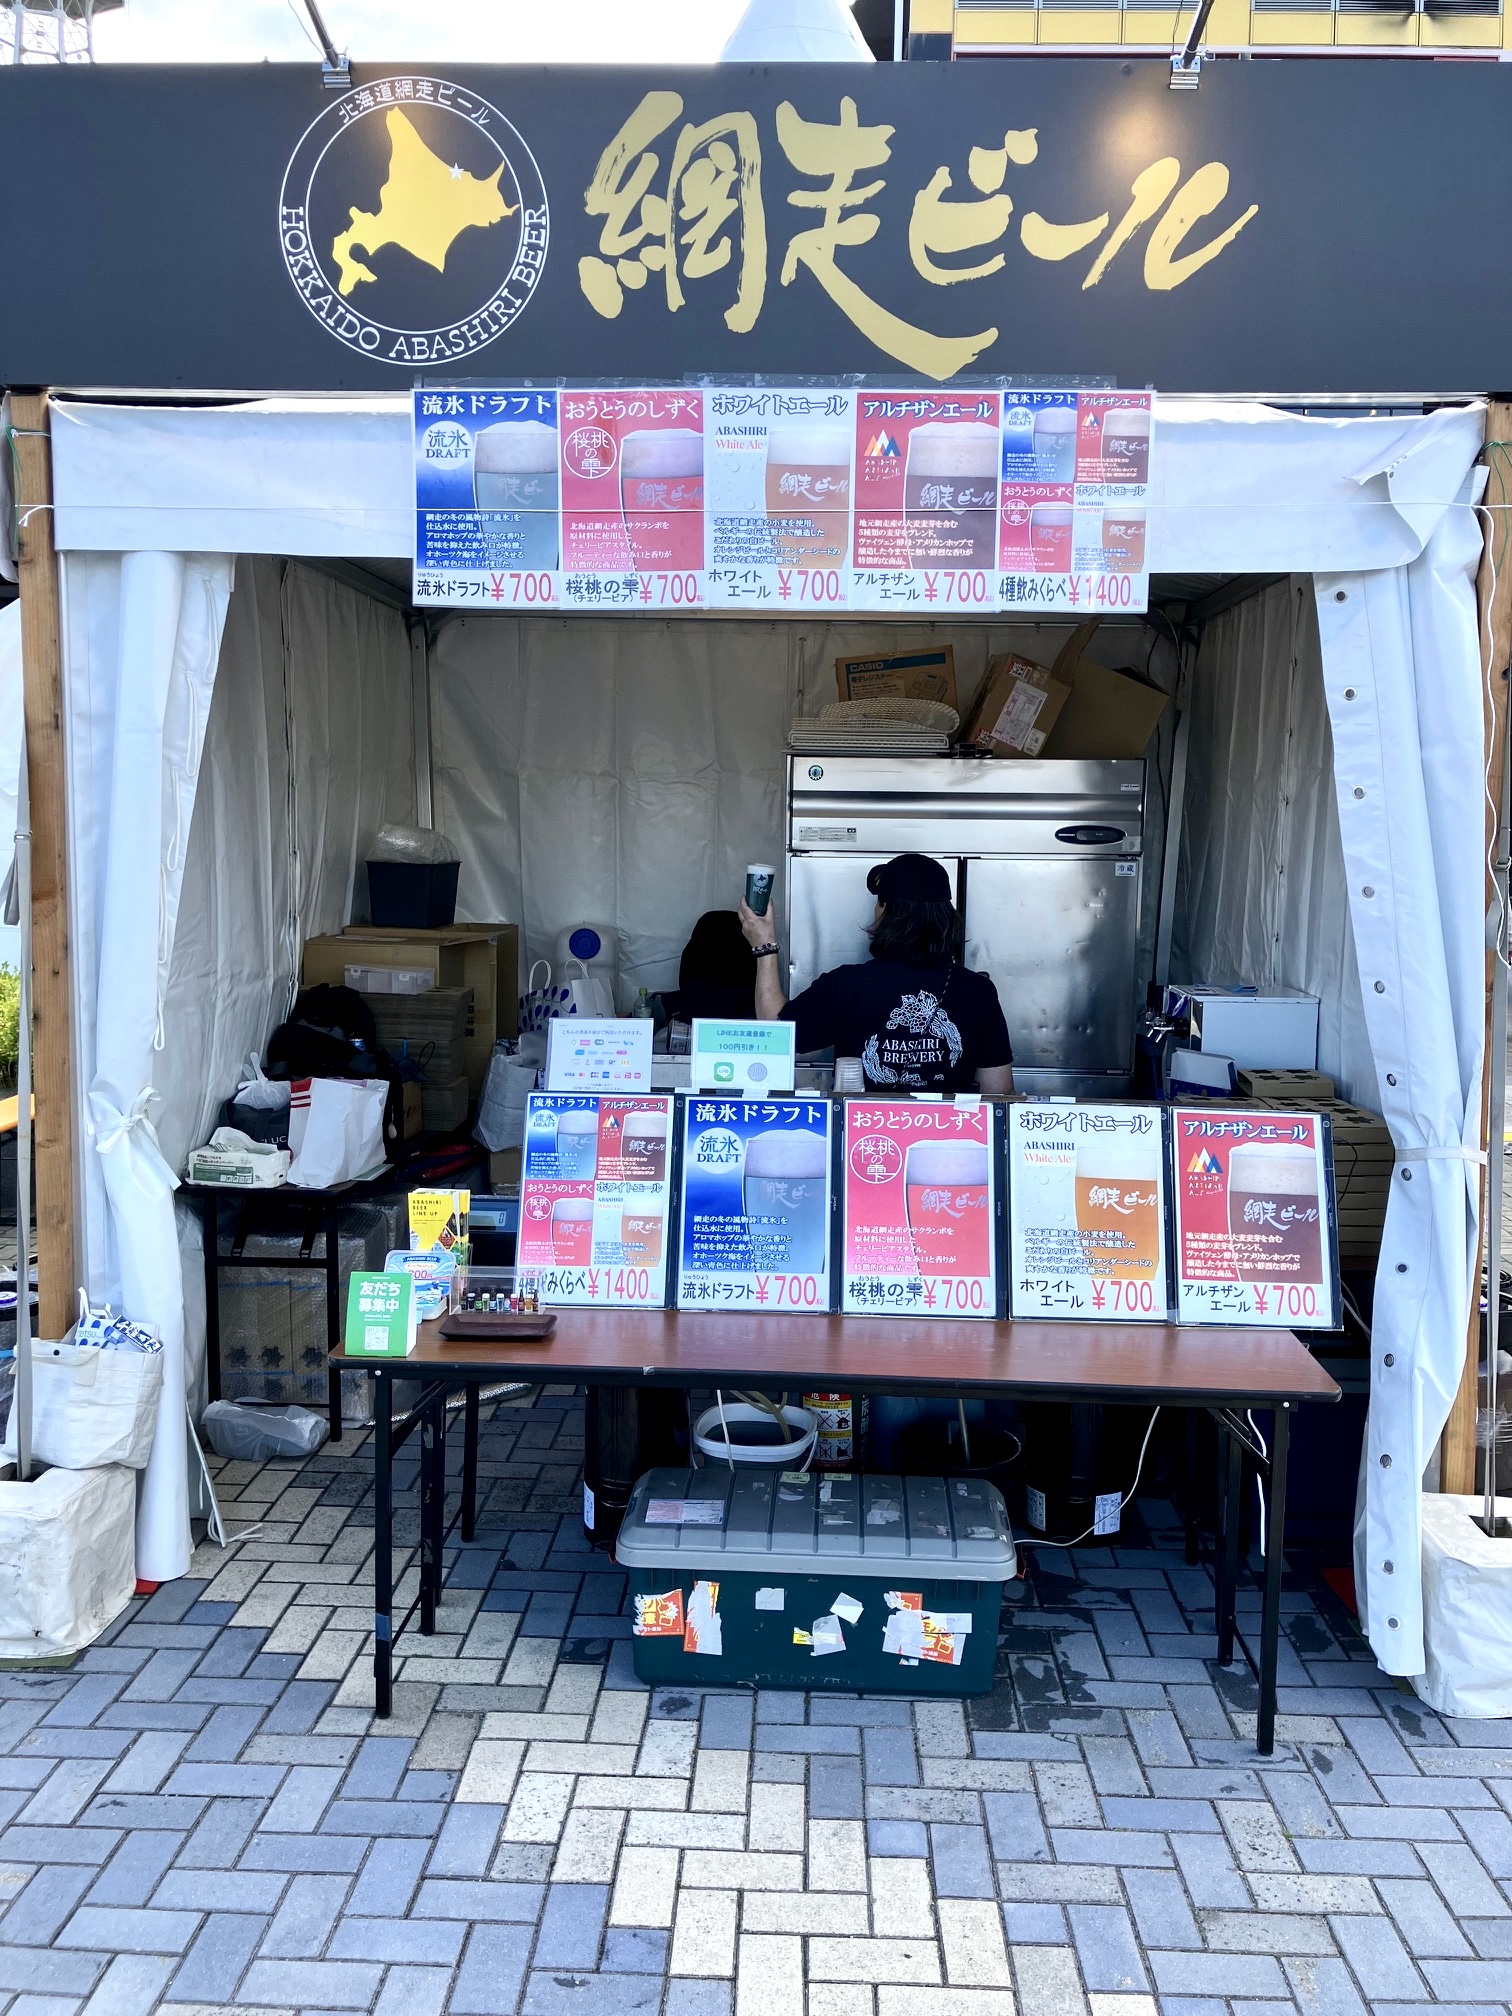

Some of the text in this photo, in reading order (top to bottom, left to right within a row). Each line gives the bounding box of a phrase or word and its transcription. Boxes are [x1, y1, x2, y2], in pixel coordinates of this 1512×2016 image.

[339, 80, 490, 124] 北海道網走ビール
[578, 90, 1259, 381] 網走ビール
[282, 204, 547, 359] HOKKAIDO ABASHIRI BEER
[422, 395, 551, 415] 流氷ドラフト
[713, 393, 848, 416] ホワイトエール
[1008, 393, 1076, 405] 流氷ドラフト
[1081, 397, 1148, 407] アルチザンエール
[565, 400, 699, 421] おうとうのしずく
[863, 400, 994, 420] アルチザンエール
[1010, 411, 1031, 421] 流氷
[428, 429, 468, 448] 流氷
[715, 426, 767, 436] ABASHIRI
[572, 432, 610, 449] 桜桃
[715, 439, 763, 450] White Ale
[426, 448, 471, 459] DRAFT
[586, 448, 598, 458] の
[779, 471, 850, 502] 網走ビール
[1004, 485, 1072, 497] おうとうのしずく
[1076, 484, 1146, 496] ホワイトエール
[920, 482, 998, 515] 網走ビール
[426, 522, 478, 531] 仕込水に使用。
[708, 569, 763, 584] ホワイト
[853, 573, 915, 587] アルチザン
[417, 573, 552, 602] 流氷ドラフト ¥700
[566, 574, 698, 604] 桜桃の雫 ¥700
[727, 570, 839, 601] エール ¥700
[879, 571, 986, 603] エール ¥700
[999, 574, 1131, 607] 4種飲みくらべ ¥1400
[850, 662, 884, 672] CASIO
[1117, 864, 1134, 872] 冷蔵
[883, 1051, 945, 1064] BREWERY
[534, 1098, 597, 1108] 流氷ドラフト
[602, 1101, 665, 1110] アルチザンエール
[696, 1103, 821, 1124] 流氷ドラフト
[853, 1110, 983, 1131] おうとうのしずく
[1020, 1111, 1153, 1134] ホワイトエール
[1184, 1120, 1309, 1142] アルチザンエール
[700, 1135, 739, 1153] 流氷
[858, 1139, 895, 1158] 桜桃
[1024, 1141, 1075, 1151] ABASHIRI
[697, 1153, 741, 1163] DRAFT
[871, 1155, 883, 1164] の
[1024, 1153, 1072, 1164] White Ale
[527, 1183, 593, 1194] おうとうのしずく
[597, 1182, 663, 1193] ホワイトエール
[1088, 1185, 1157, 1215] 網走ビール
[1243, 1199, 1319, 1230] 網走ビール
[693, 1224, 745, 1233] 仕込水に使用。
[360, 1281, 401, 1296] 友だち
[588, 1268, 649, 1300] ¥1400
[683, 1275, 817, 1305] 流氷ドラフト ¥700
[1020, 1279, 1075, 1293] ホワイト
[1183, 1284, 1244, 1298] アルチザン
[849, 1279, 983, 1310] 桜桃の雫 ¥700
[1040, 1280, 1153, 1312] エール ¥700
[1210, 1285, 1316, 1316] エール ¥700
[359, 1298, 399, 1312] 募集中
